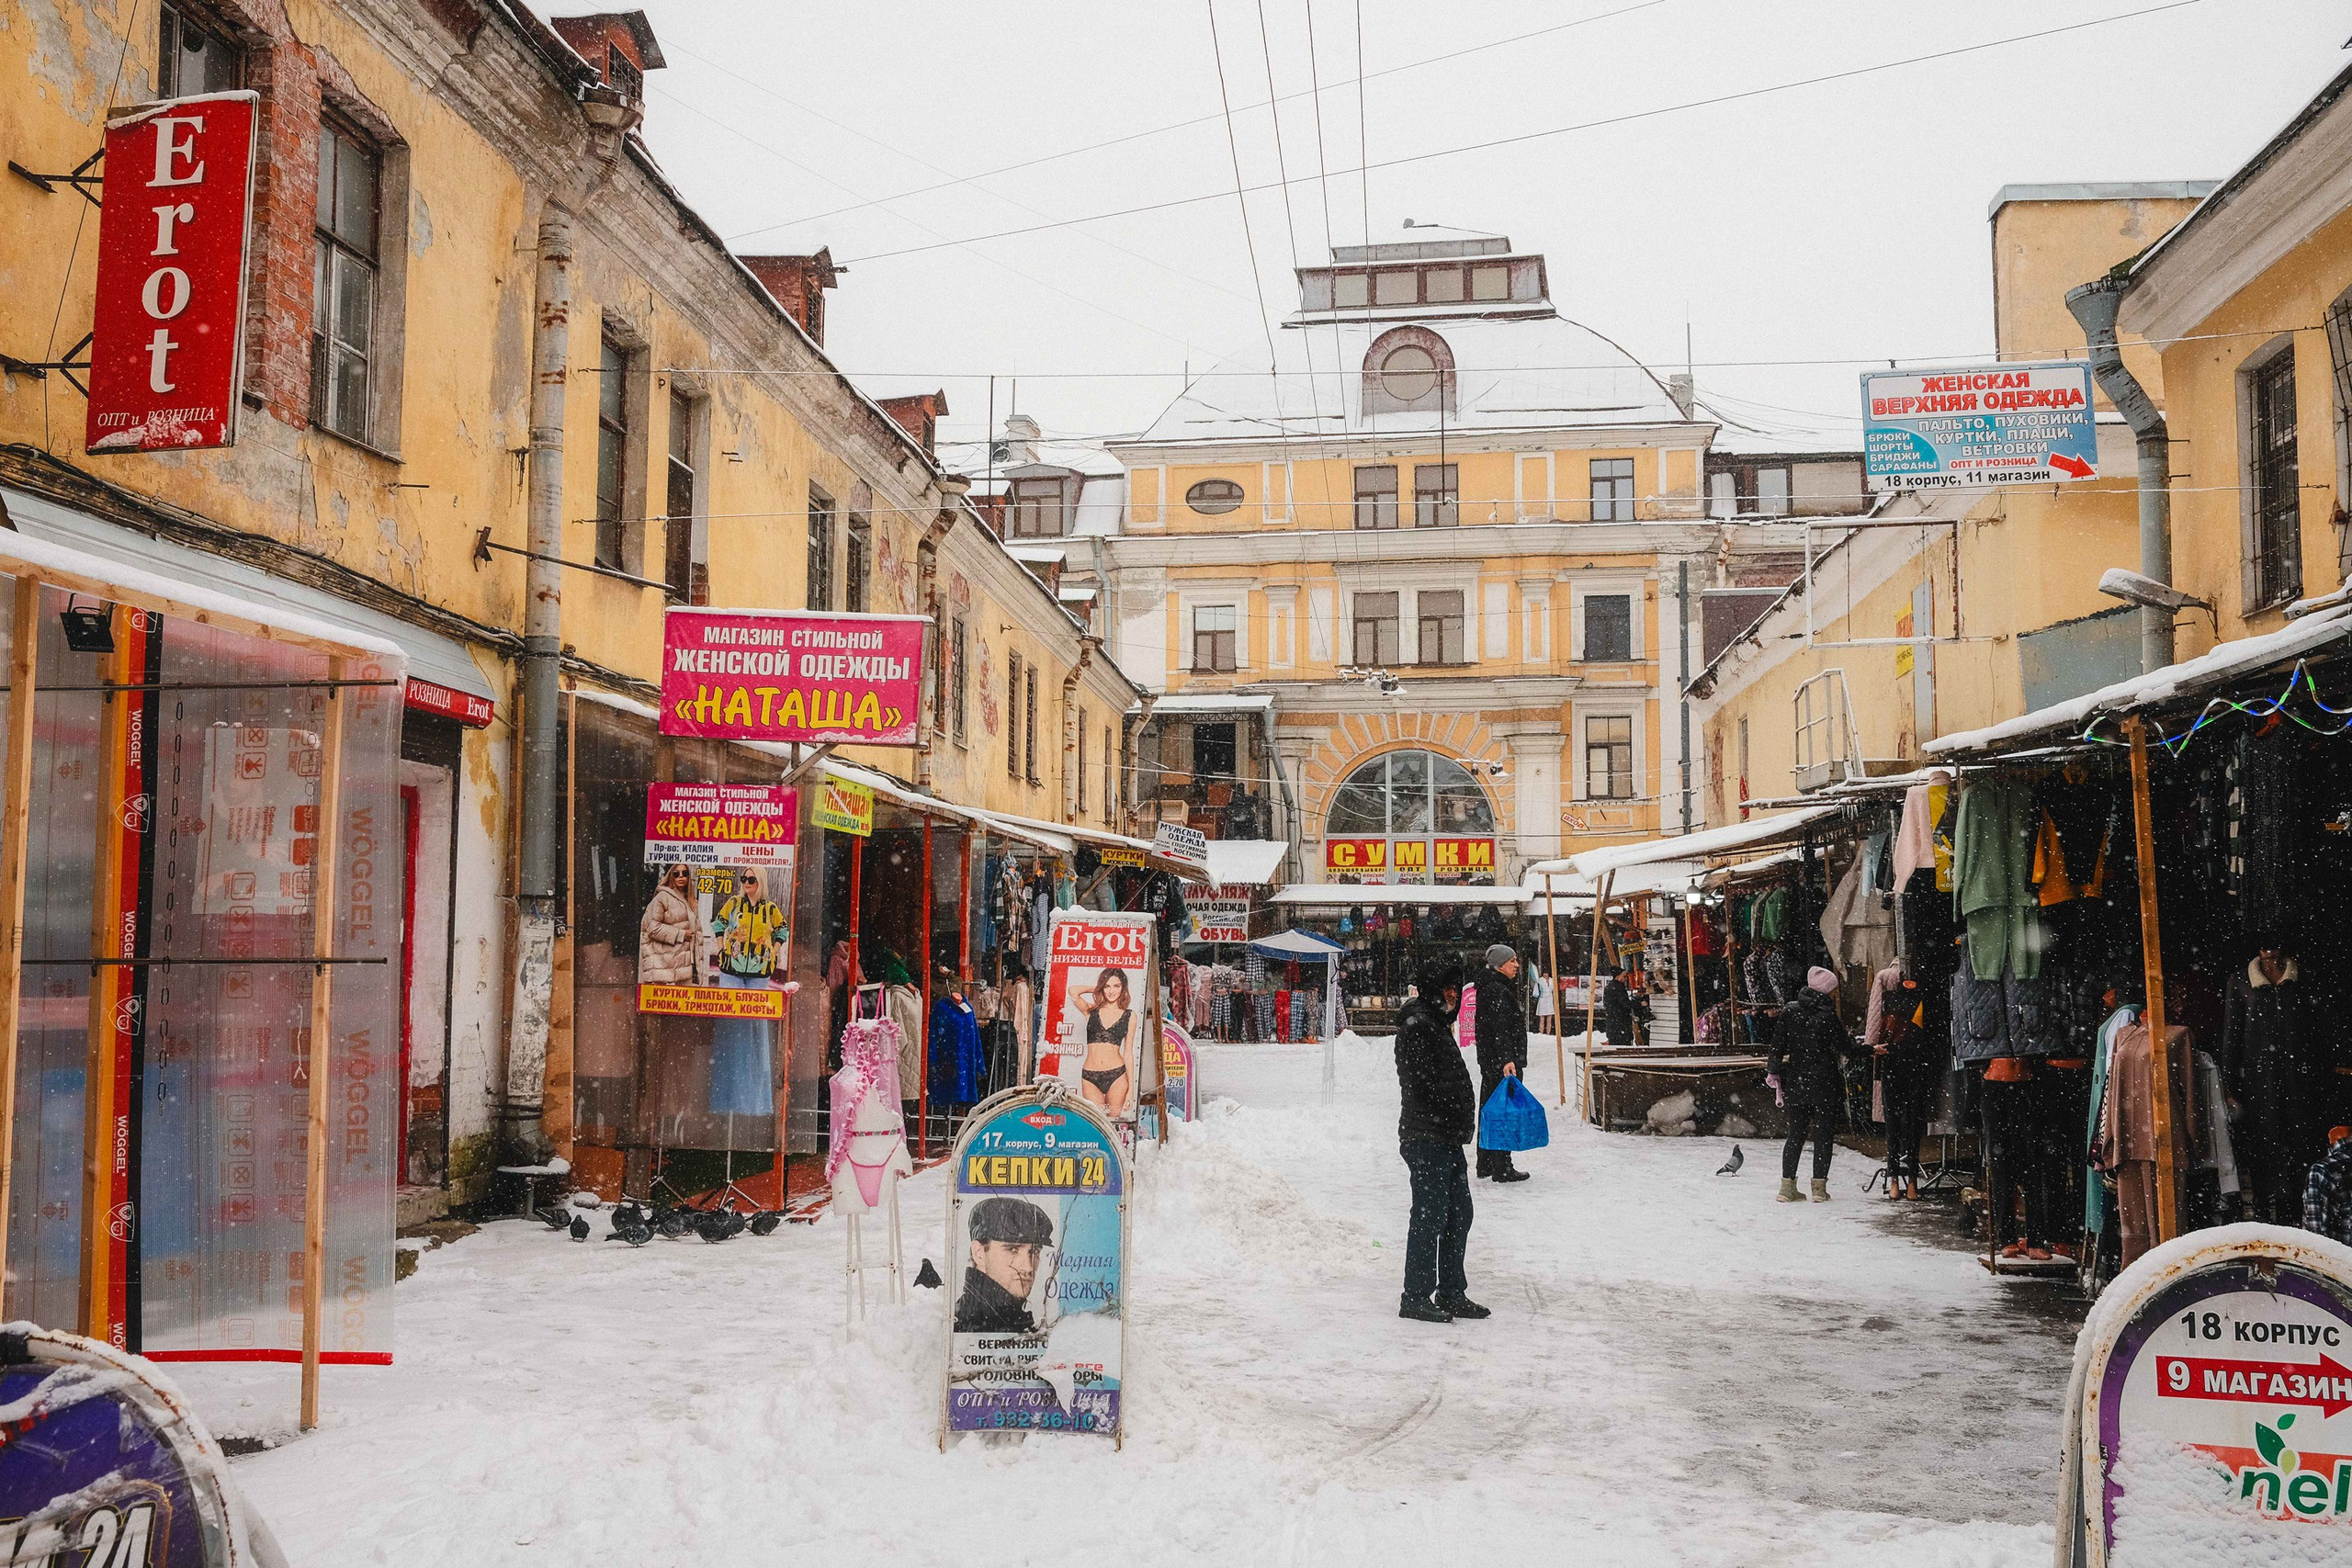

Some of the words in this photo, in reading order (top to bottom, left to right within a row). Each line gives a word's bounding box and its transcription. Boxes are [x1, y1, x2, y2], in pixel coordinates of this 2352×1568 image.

[141, 116, 204, 393] Erot
[1922, 372, 2030, 393] ЖЕНСКАЯ
[1872, 393, 1977, 415] ВЕРХНЯЯ
[1984, 388, 2085, 412] ОДЕЖДА
[97, 412, 130, 426] ОПТ
[1917, 418, 1990, 432] ПАЛЬТО,
[1995, 412, 2089, 428] ПУХОВИКИ,
[1868, 433, 1910, 442] БРЮКИ
[1935, 431, 2002, 445] КУРТКИ,
[2007, 427, 2074, 441] ПЛАЩИ,
[1869, 443, 1914, 452] ШОРТЫ
[1962, 442, 2049, 457] ВЕТРОВКИ
[1870, 452, 1920, 462] БРИДЖИ
[1951, 460, 1972, 468] ОПТ
[1986, 457, 2037, 467] РОЗНИЦА
[1871, 461, 1937, 472] САРАФАНЫ
[1884, 476, 1901, 487] 18
[1906, 473, 1962, 489] корпус,
[1966, 471, 1982, 482] 11
[1988, 470, 2051, 482] магазин
[704, 626, 784, 647] МАГАЗИН
[791, 630, 883, 649] СТИЛЬНОЙ
[673, 648, 790, 676] ЖЕНСКОЙ
[800, 654, 910, 682] ОДЕЖДЫ
[409, 682, 450, 709] РОЗНИЦА
[467, 696, 490, 719] Erot
[674, 683, 902, 731] «НАТАША»
[675, 787, 717, 798] МАГАЗИН
[719, 788, 769, 799] СТИЛЬНОЙ
[659, 799, 720, 814] ЖЕНСКОЙ
[725, 801, 784, 817] ОДЕЖДЫ
[655, 816, 785, 840] «НАТАША»
[1159, 823, 1202, 840] МУЖСКАЯ
[654, 843, 679, 854] Пр-во:
[683, 844, 714, 853] ИТАЛИЯ
[1168, 833, 1204, 848] ОДЕЖДА
[1171, 841, 1207, 854] СПОРТИВНЫЕ
[649, 852, 682, 863] ТУРЦИЯ,
[685, 854, 718, 863] РОССИЯ
[742, 846, 775, 856] ЦЕНЫ
[1103, 850, 1144, 861] КУРТКИ
[1173, 848, 1206, 861] КОСТЮМЫ
[1333, 842, 1489, 865] СУМКИ
[696, 868, 736, 877] размеры:
[696, 878, 732, 895] 42-70
[1183, 885, 1250, 901] МУФЛЯЖ
[1186, 903, 1209, 911] ОЧАЯ
[1212, 903, 1247, 913] ОДЕЖДА
[1057, 924, 1141, 953] Erot
[1200, 928, 1247, 941] ОБУВЬ
[1053, 954, 1103, 964] НИЖНЕЕ
[1106, 955, 1143, 965] БЕЛЬЁ
[653, 987, 691, 999] КУРТКИ,
[695, 990, 731, 1002] ПЛАТЬЯ,
[735, 992, 769, 1003] БЛУЗЫ
[646, 999, 681, 1011] БРЮКИ,
[685, 1001, 736, 1014] ТРИКОТАЖ,
[740, 1004, 775, 1015] КОФТЫ
[1057, 1021, 1074, 1035] Опт
[1049, 1043, 1083, 1056] озница
[982, 1132, 1003, 1147] 17
[1005, 1140, 1042, 1149] корпус,
[1045, 1133, 1056, 1148] 9
[968, 1156, 1075, 1187] КЕПКИ
[1080, 1156, 1106, 1187] 24
[1046, 1252, 1114, 1272] Модная
[1046, 1276, 1114, 1300] Одежда
[2181, 1311, 2222, 1339] 18
[2234, 1321, 2341, 1346] КОРПУС
[2167, 1360, 2190, 1392] 9
[2204, 1369, 2352, 1402] МАГАЗИН
